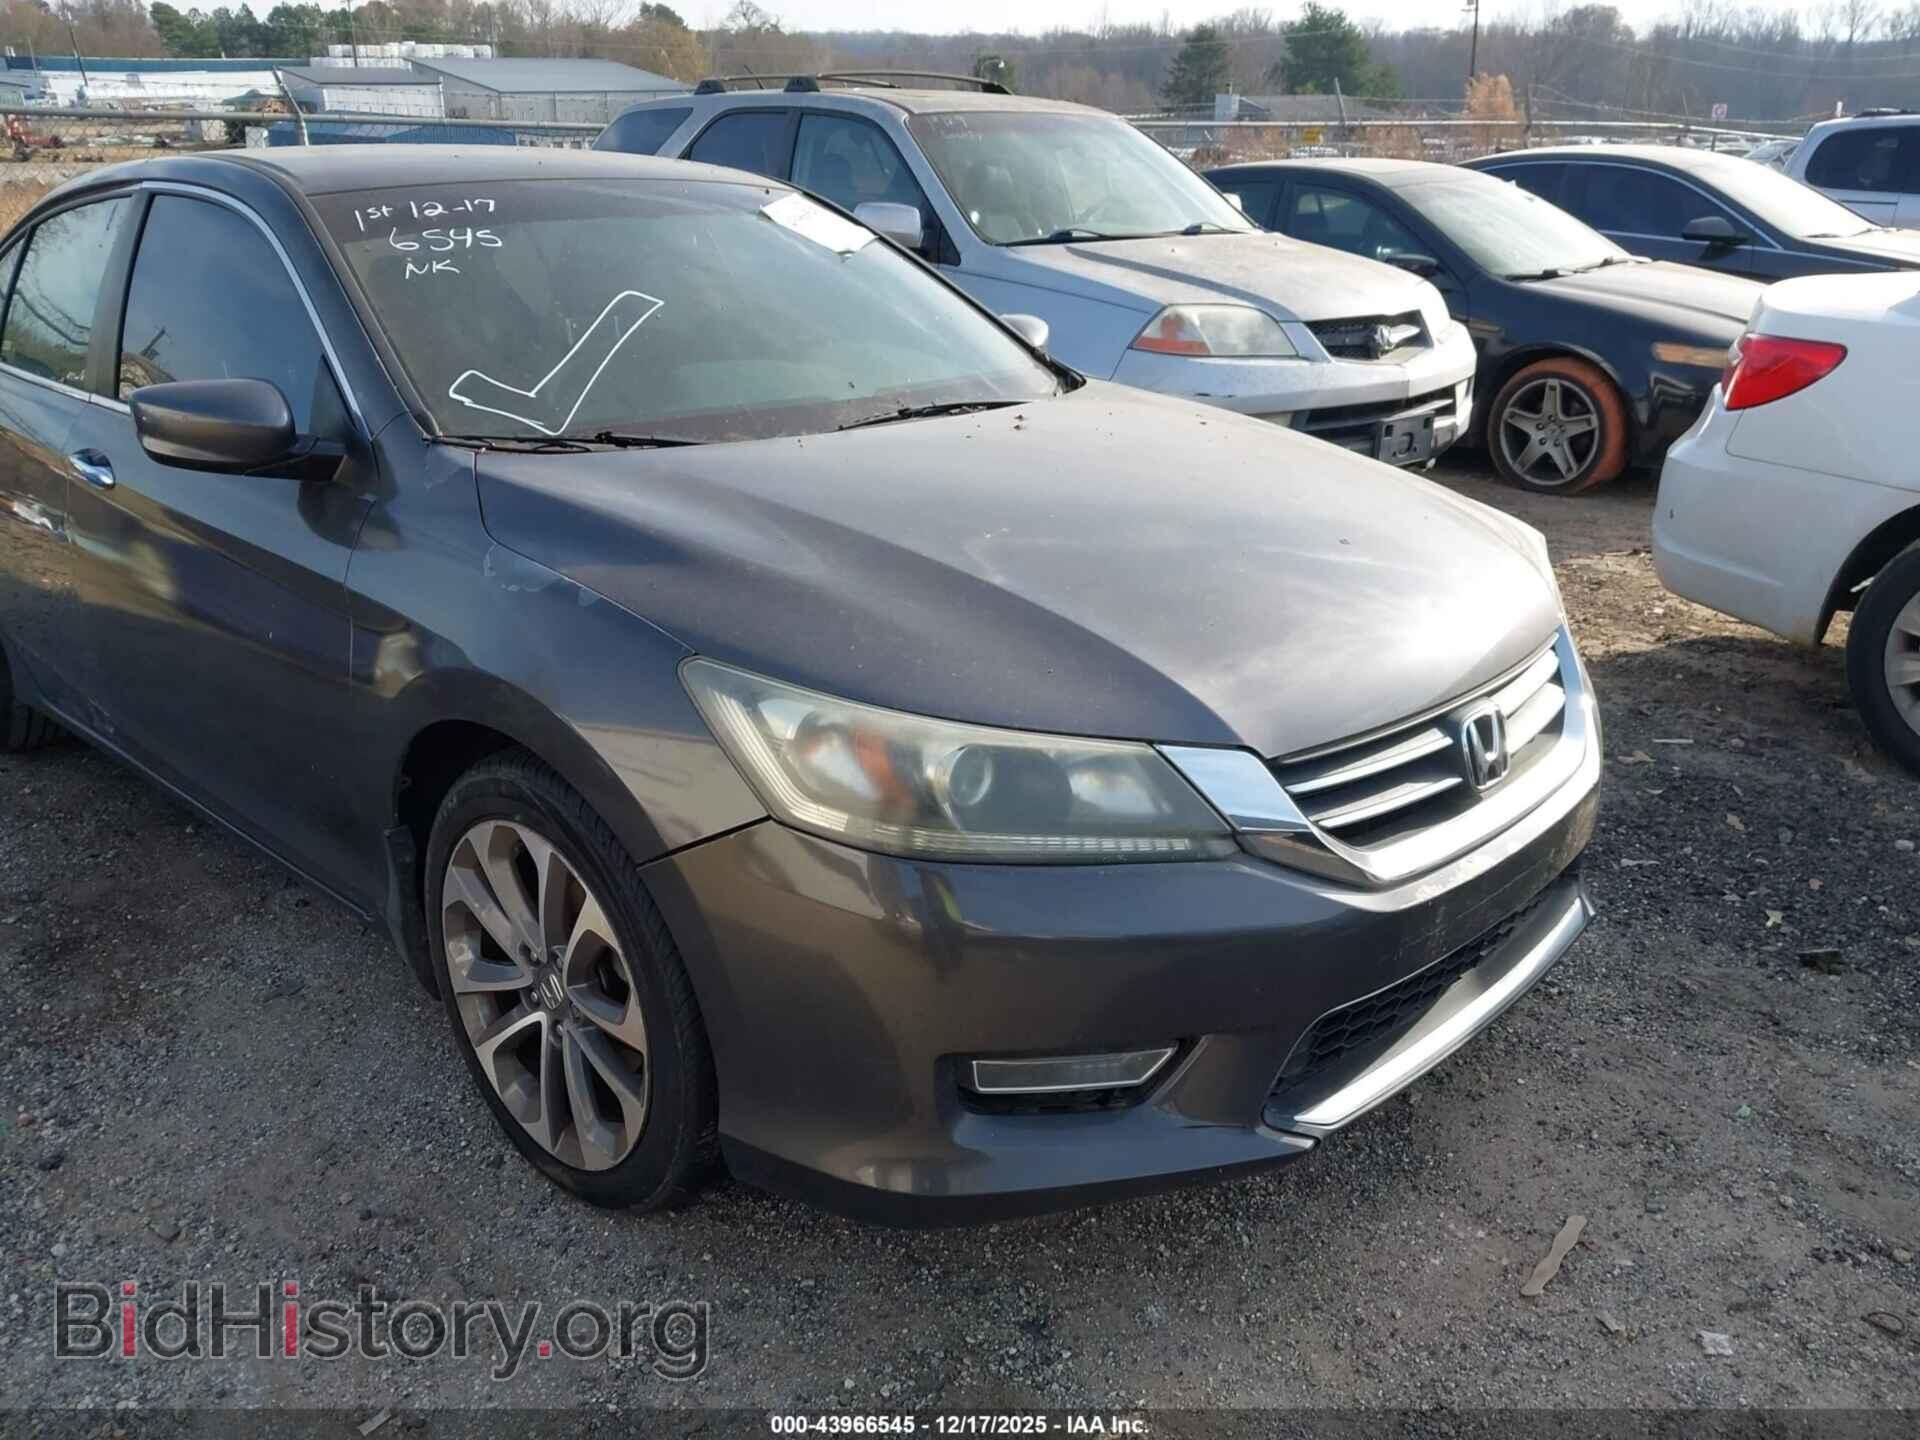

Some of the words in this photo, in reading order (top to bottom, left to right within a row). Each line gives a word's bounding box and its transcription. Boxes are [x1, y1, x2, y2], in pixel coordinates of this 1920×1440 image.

[354, 205, 393, 232] 1st
[409, 198, 496, 219] 12-17
[389, 227, 503, 251] 6545
